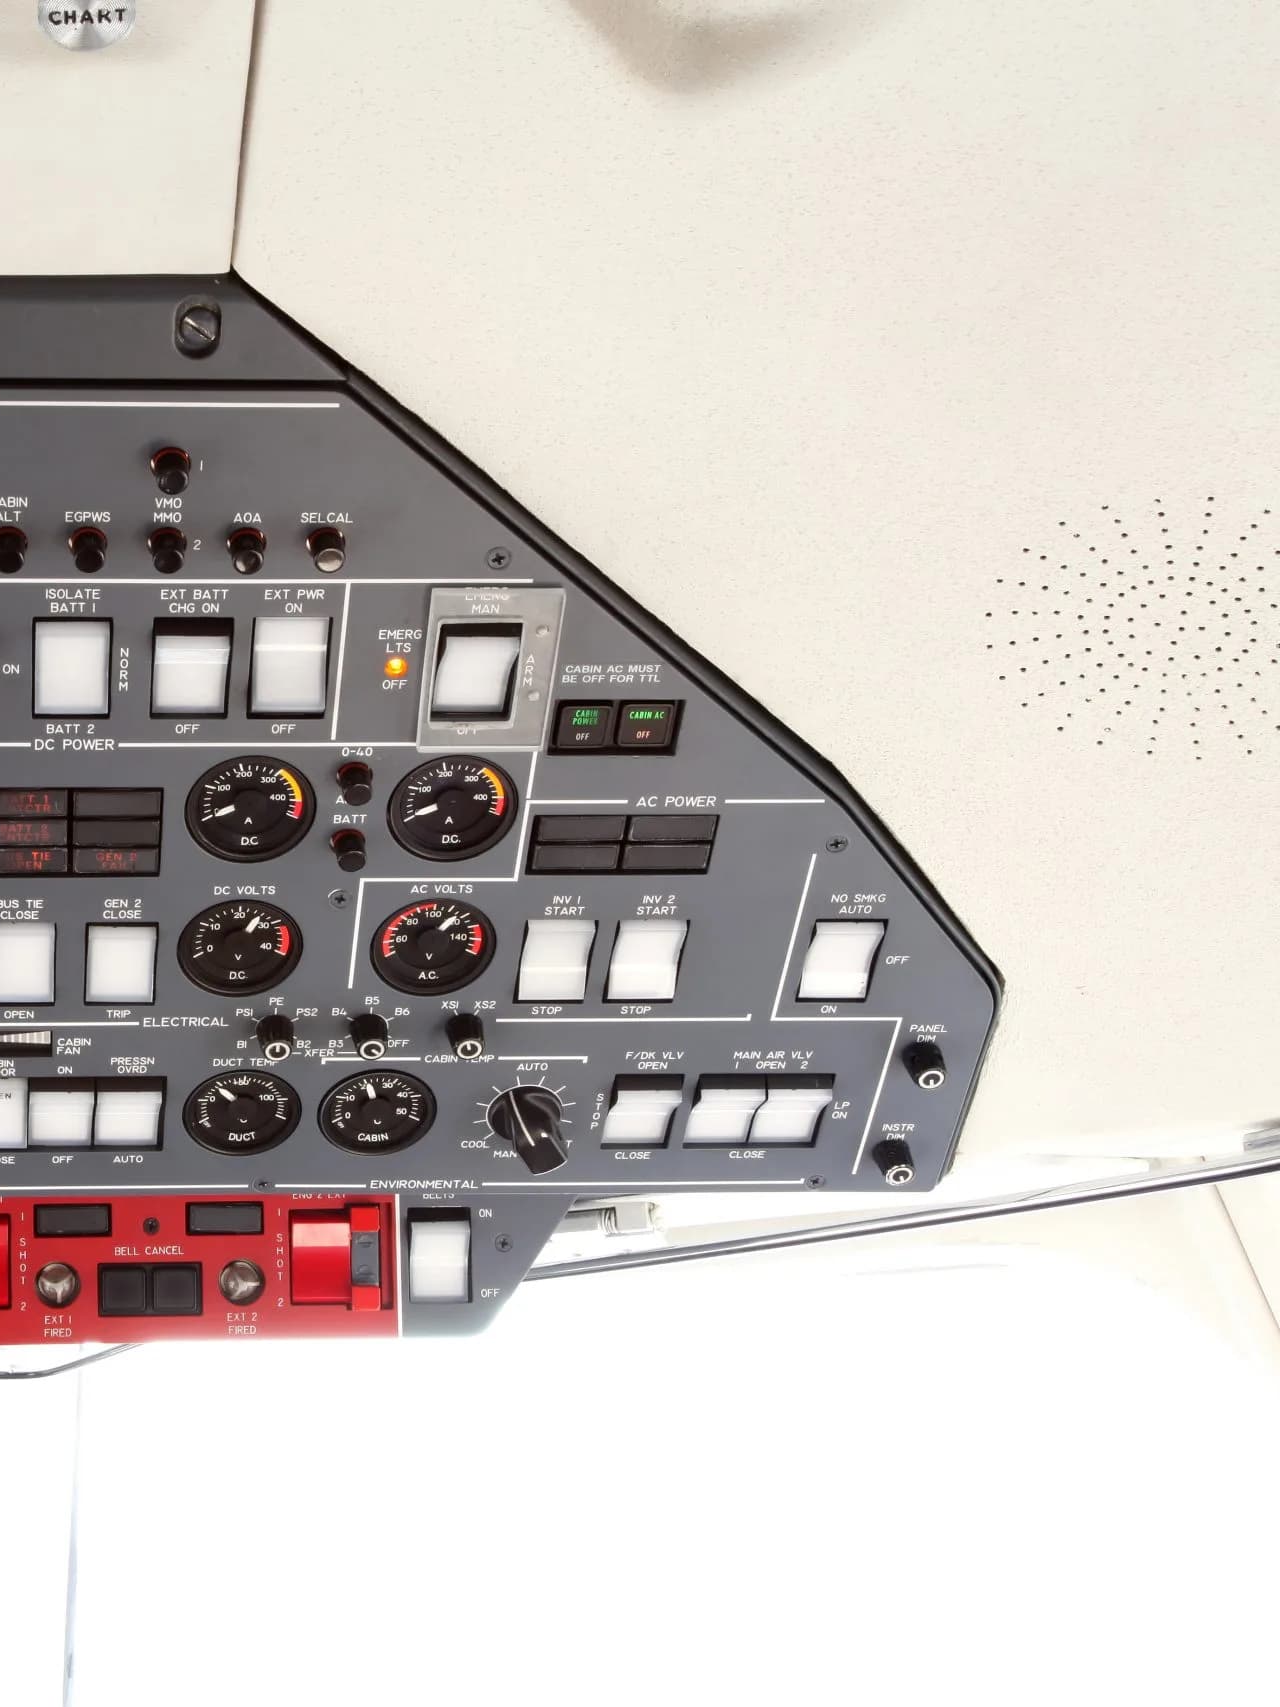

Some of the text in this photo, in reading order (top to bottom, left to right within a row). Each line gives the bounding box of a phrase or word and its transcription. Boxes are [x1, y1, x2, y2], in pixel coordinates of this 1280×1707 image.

[47, 7, 127, 27] CHART
[154, 497, 183, 509] VMO
[64, 511, 111, 523] EGPWS
[153, 511, 183, 523] MMO
[233, 511, 262, 524] AOA
[300, 511, 354, 524] SELCAL
[45, 587, 101, 600] ISOLATE
[160, 588, 230, 601] EXT BATT
[264, 588, 326, 601] EXT PWR
[50, 601, 87, 614] BATT
[168, 602, 220, 614] CHG ON
[284, 602, 303, 614] ON
[471, 603, 500, 614] MAN
[378, 628, 423, 641] EMERG
[385, 642, 412, 654] LTS
[565, 664, 662, 674] CABIN AC MUST
[562, 673, 661, 683] BE FOR TTL
[381, 679, 408, 690] OFF
[628, 710, 664, 720] CABIN AC
[271, 723, 297, 735] OFF
[635, 730, 651, 740] OFF
[34, 738, 115, 751] DC POWER
[235, 770, 253, 779] 200
[269, 793, 287, 802] 400
[664, 795, 717, 808] POWER
[31, 850, 52, 861] TIE
[236, 885, 276, 896] VOLTS
[434, 884, 473, 894] VOLTS
[552, 895, 573, 905] INV
[830, 893, 887, 904] NO SMKG
[0, 909, 40, 920] CLOSE
[102, 909, 142, 920] CLOSE
[838, 904, 873, 915] AUTO
[449, 932, 468, 942] 140
[473, 1000, 497, 1010] XS2
[531, 1005, 563, 1015] STOP
[3, 1010, 35, 1020] OPEN
[295, 1007, 319, 1017] PS2
[142, 1016, 230, 1029] ELECTRICAL
[909, 1023, 948, 1033] PANEL
[56, 1037, 92, 1047] CABIN
[56, 1046, 82, 1056] FAN
[303, 1049, 336, 1059] XFER
[625, 1051, 685, 1061] F/DK VLV
[733, 1050, 814, 1060] MAIN AIR VLV
[110, 1056, 156, 1067] PRESSN
[212, 1057, 245, 1067] DUCT
[516, 1062, 549, 1072] AUTO
[637, 1061, 669, 1071] OPEN
[755, 1060, 787, 1070] OPEN
[117, 1065, 149, 1075] OVRD
[258, 1093, 275, 1102] 100
[881, 1123, 916, 1132] INSTR
[227, 1130, 256, 1143] DUCT
[460, 1139, 490, 1149] COOL
[51, 1155, 74, 1164] OFF
[369, 1179, 479, 1190] ENVIRONMENTAL
[114, 1245, 185, 1257] BELL CANCEL
[43, 1327, 72, 1338] FIRED
